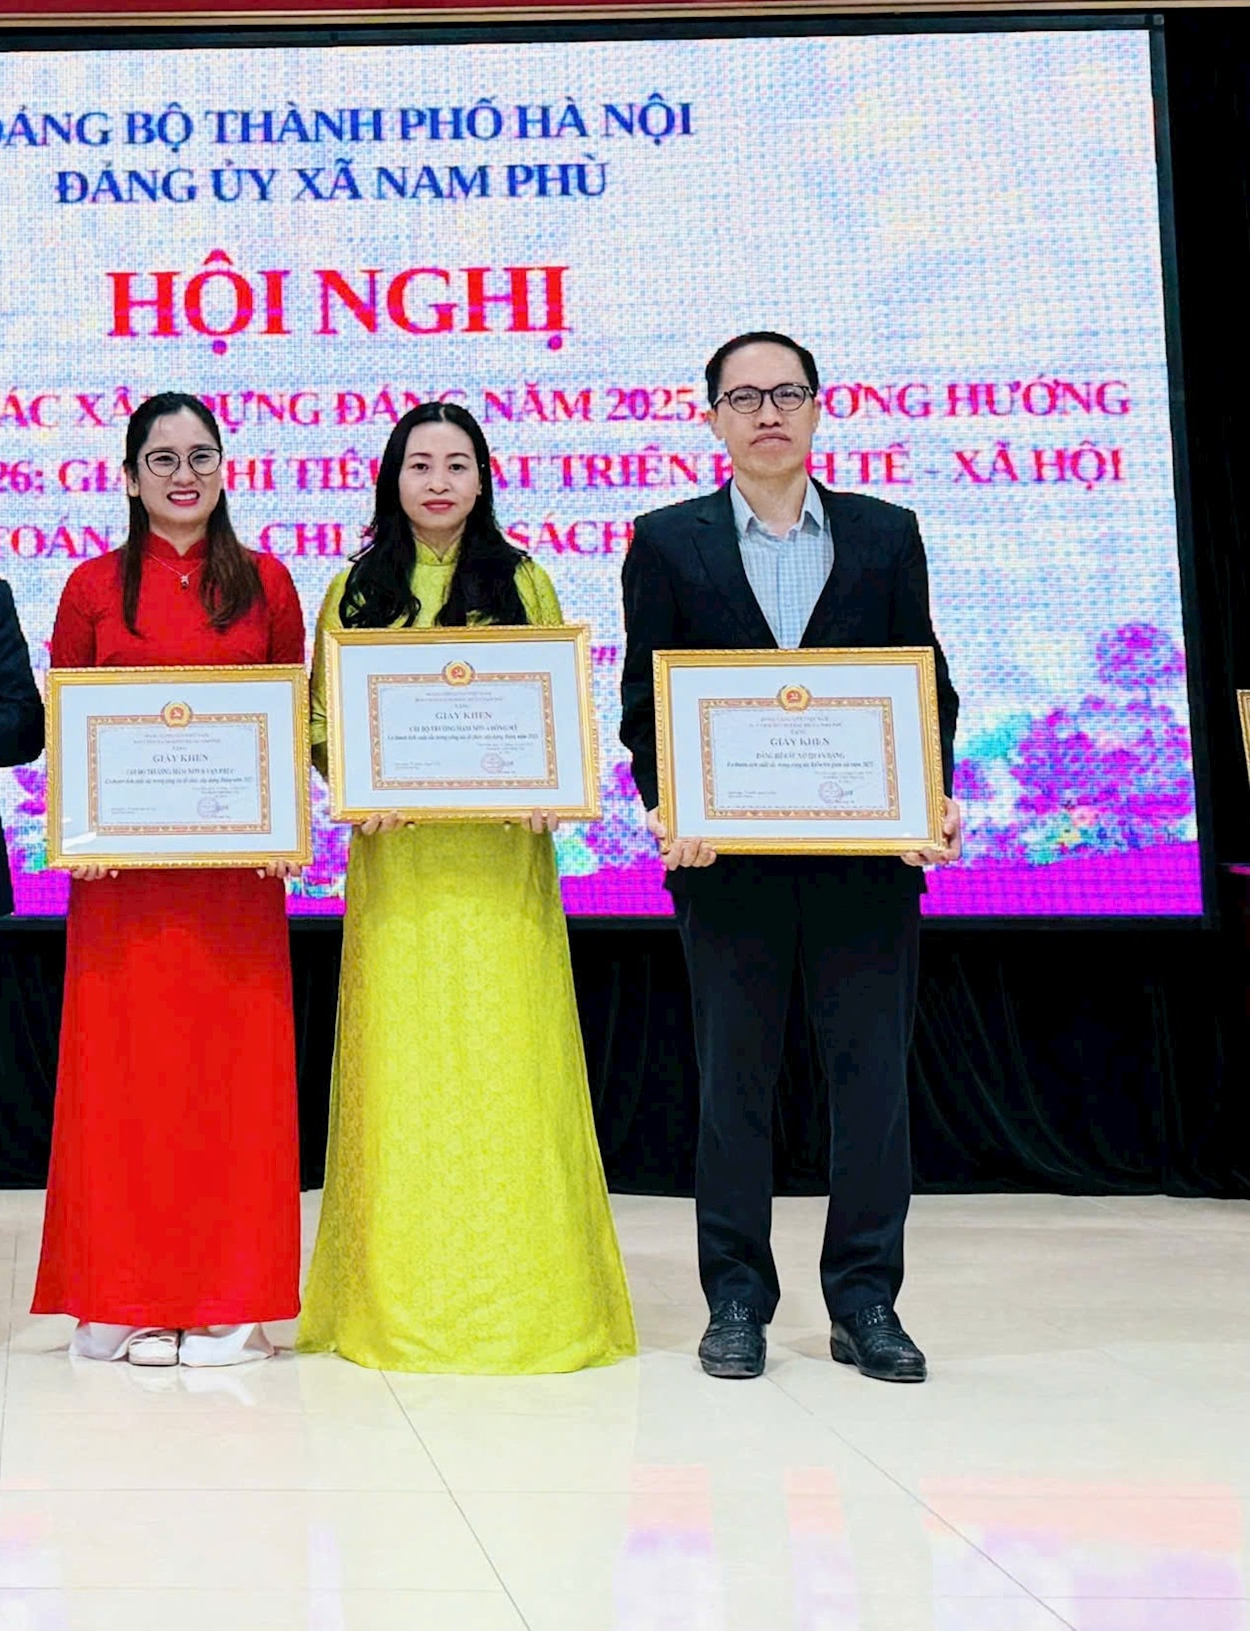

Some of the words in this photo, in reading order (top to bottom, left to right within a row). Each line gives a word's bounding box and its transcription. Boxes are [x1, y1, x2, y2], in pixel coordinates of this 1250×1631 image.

[125, 101, 195, 152] BỘ
[205, 100, 385, 144] THÀNH
[399, 96, 503, 141] PHỐ
[513, 96, 589, 139] HÀ
[602, 93, 694, 146] NỘI
[54, 160, 199, 204] ĐẢNG
[209, 158, 283, 203] ỦY
[292, 158, 363, 202] XÃ
[375, 164, 494, 200] NAM
[505, 153, 610, 198] PHÙ
[106, 249, 292, 356] HỘI
[313, 265, 571, 351] NGHỊ
[75, 386, 151, 427] XÂ
[482, 383, 592, 424] NĂM
[944, 373, 1130, 417] HƯỚNG
[848, 439, 913, 485] TẾ
[952, 440, 1019, 484] XÃ
[1031, 439, 1125, 491] HỘI
[259, 522, 344, 557] CHI
[505, 513, 634, 555] SÁCH
[463, 710, 493, 720] KHEN
